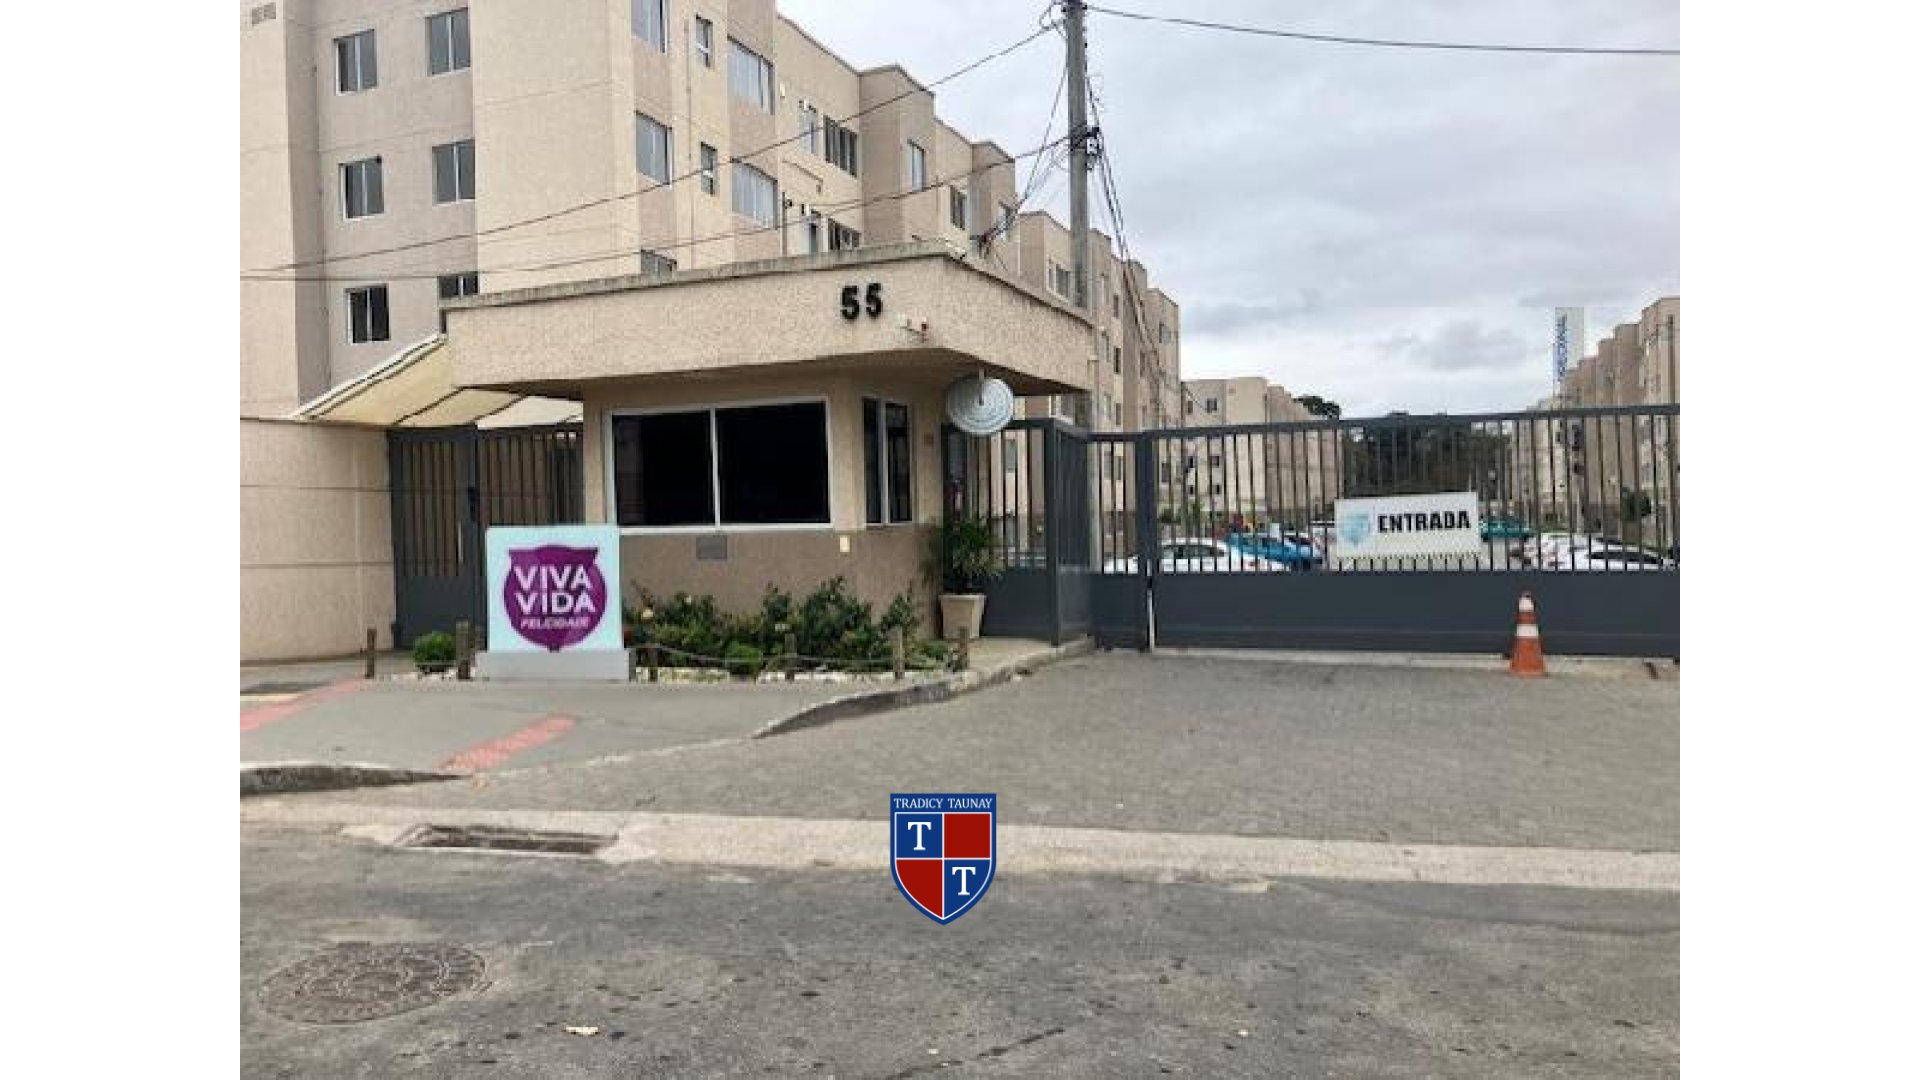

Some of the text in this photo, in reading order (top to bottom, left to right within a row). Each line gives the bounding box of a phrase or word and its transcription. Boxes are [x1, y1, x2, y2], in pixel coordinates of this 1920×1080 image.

[840, 282, 883, 320] 55
[1377, 510, 1471, 533] ENTRADA
[514, 564, 594, 591] VIVA
[514, 591, 596, 615] VIDA
